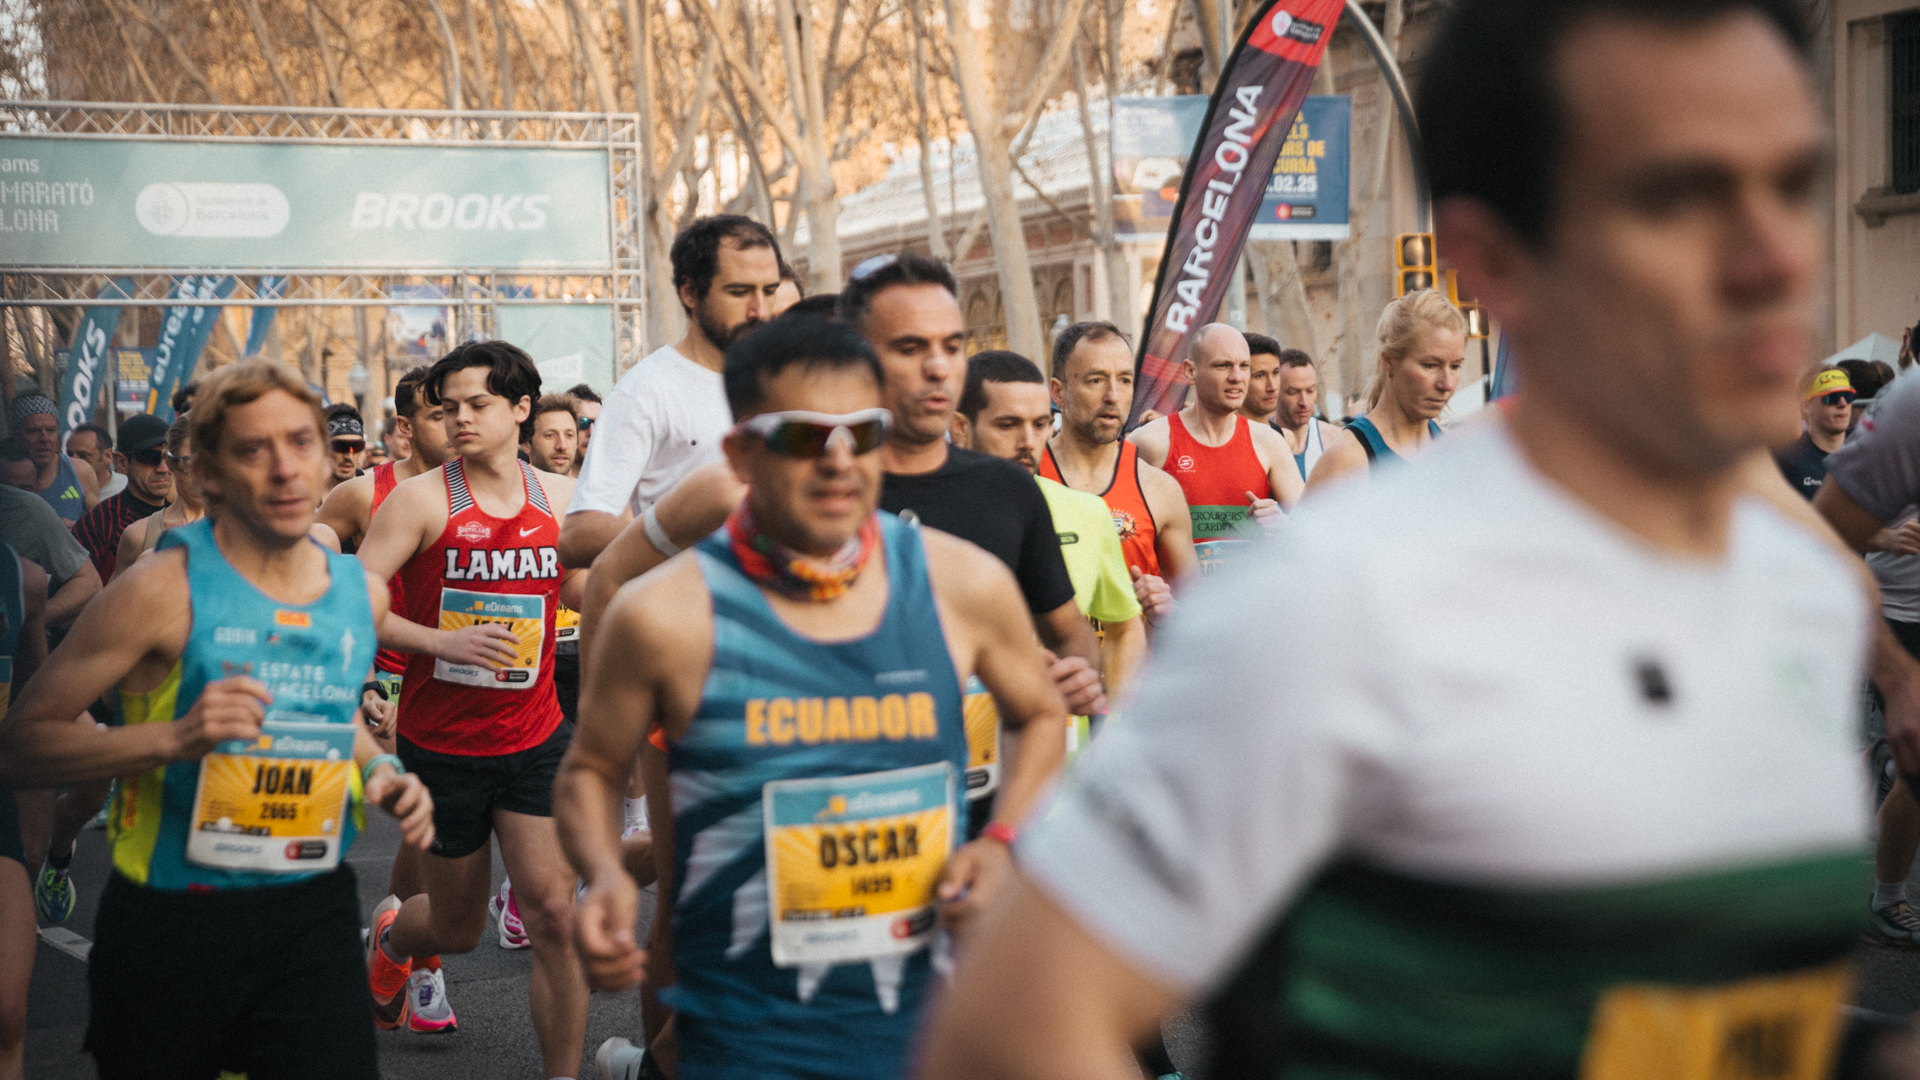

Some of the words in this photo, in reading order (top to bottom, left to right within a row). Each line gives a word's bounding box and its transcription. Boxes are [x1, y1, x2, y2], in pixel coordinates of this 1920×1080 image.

[1307, 140, 1325, 158] DE
[0, 158, 40, 173] ams
[1265, 174, 1317, 193] .02.25
[350, 192, 550, 231] BROOKS
[1166, 84, 1264, 333] BARCELONA
[457, 526, 491, 536] SOUTHLAND
[444, 546, 559, 581] LAMAR
[485, 601, 523, 614] eDreams
[259, 661, 326, 683] ESTATE
[448, 666, 479, 677] BROOKS
[745, 692, 938, 747] ECUADOR
[252, 764, 313, 795] JOAN
[819, 824, 919, 868] OSCAR
